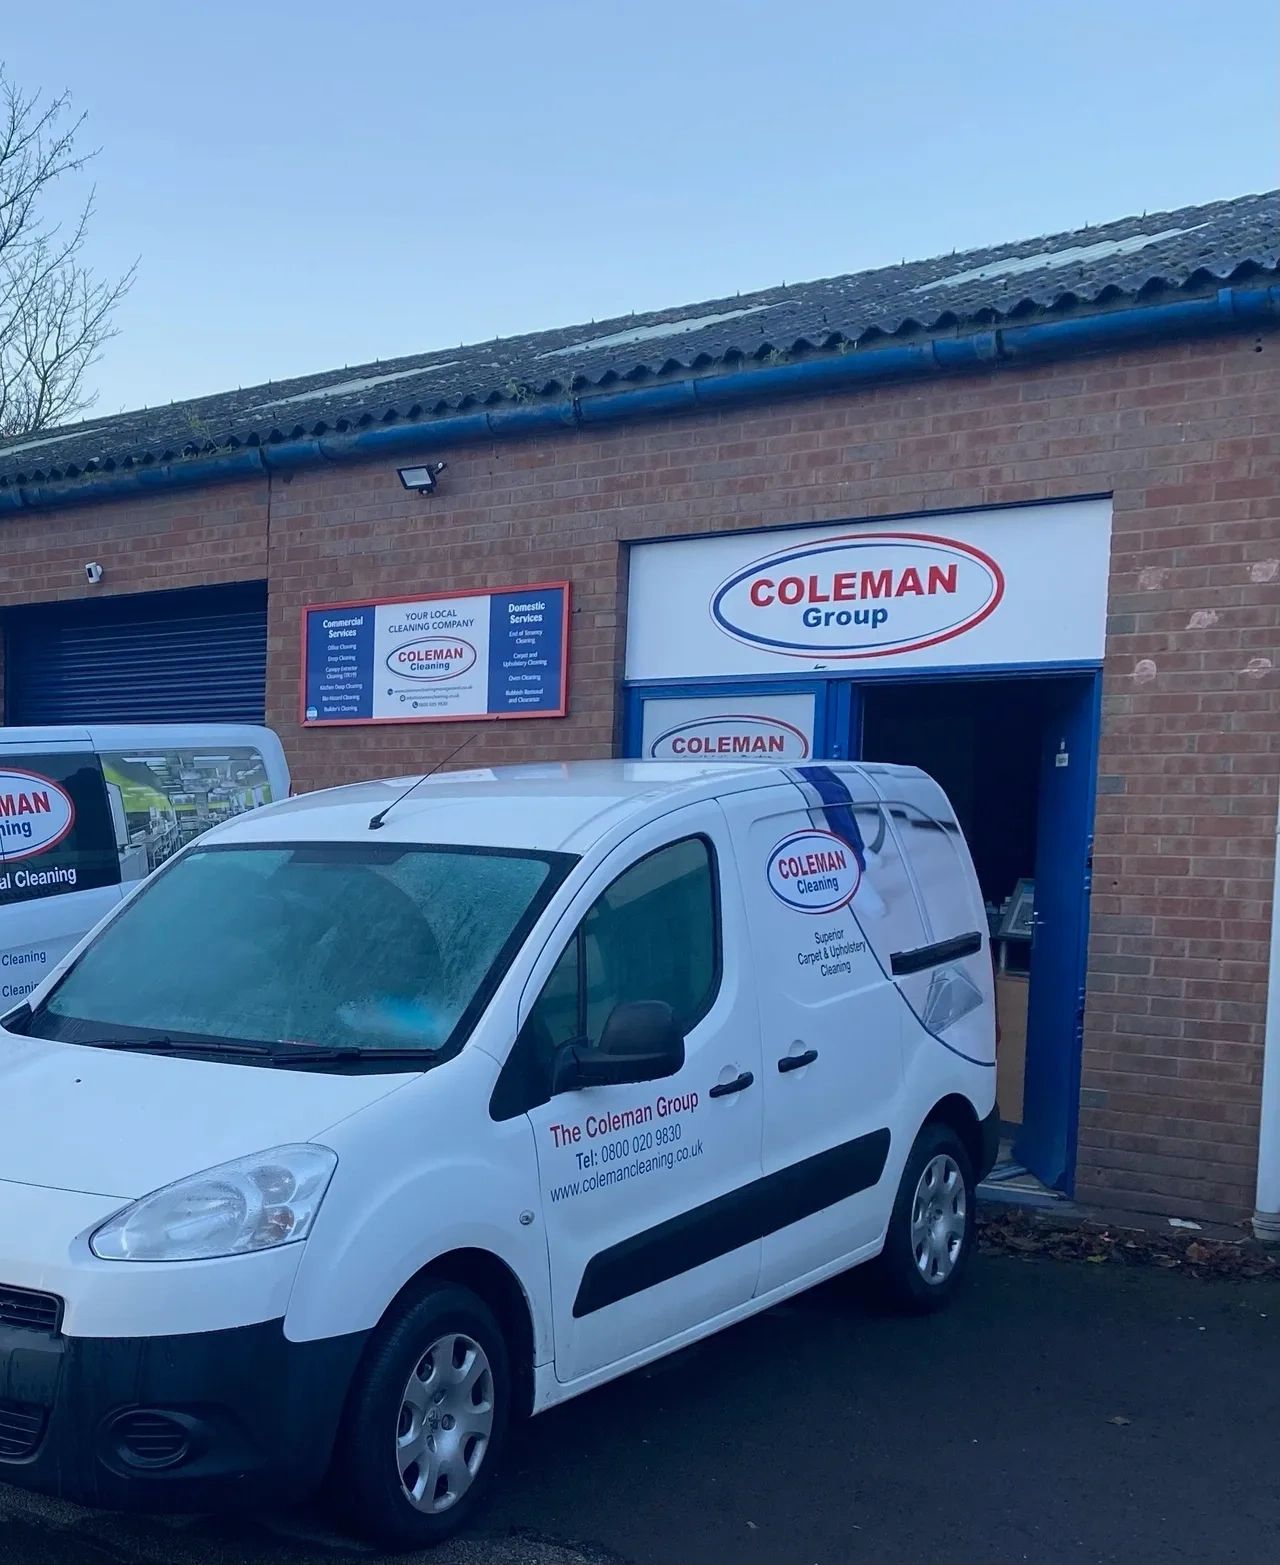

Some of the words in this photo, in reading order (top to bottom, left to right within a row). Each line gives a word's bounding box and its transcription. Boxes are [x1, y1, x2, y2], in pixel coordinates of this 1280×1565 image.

[750, 563, 958, 608] COLEMAN
[405, 612, 428, 620] YOUR
[430, 609, 457, 619] LOCAL
[508, 602, 546, 613] Domestic
[322, 616, 363, 628] Commercial
[388, 623, 430, 633] CLEANING
[432, 619, 474, 630] COMPANY
[510, 614, 543, 624] Services
[802, 607, 889, 630] Group
[328, 628, 357, 638] Services
[398, 648, 464, 662] COLEMAN
[410, 662, 450, 671] Cleaning
[672, 735, 784, 753] COLEMAN
[778, 850, 847, 880] COLEMAN
[14, 866, 78, 888] Cleaning
[797, 876, 839, 894] Cleaning
[814, 928, 844, 944] Superior
[1, 951, 46, 966] Cleaning
[797, 950, 822, 966] Carpet
[824, 947, 829, 959] &
[830, 941, 866, 959] Upholstery
[820, 961, 851, 977] Cleaning
[550, 1124, 582, 1148] The
[586, 1105, 652, 1138] Coleman
[656, 1092, 698, 1118] Group
[576, 1152, 598, 1170] Tel:
[601, 1139, 629, 1163] 0800
[632, 1132, 652, 1154] 020
[655, 1123, 682, 1145] 9830
[550, 1138, 703, 1202] www.colemancleaning.co.uk
